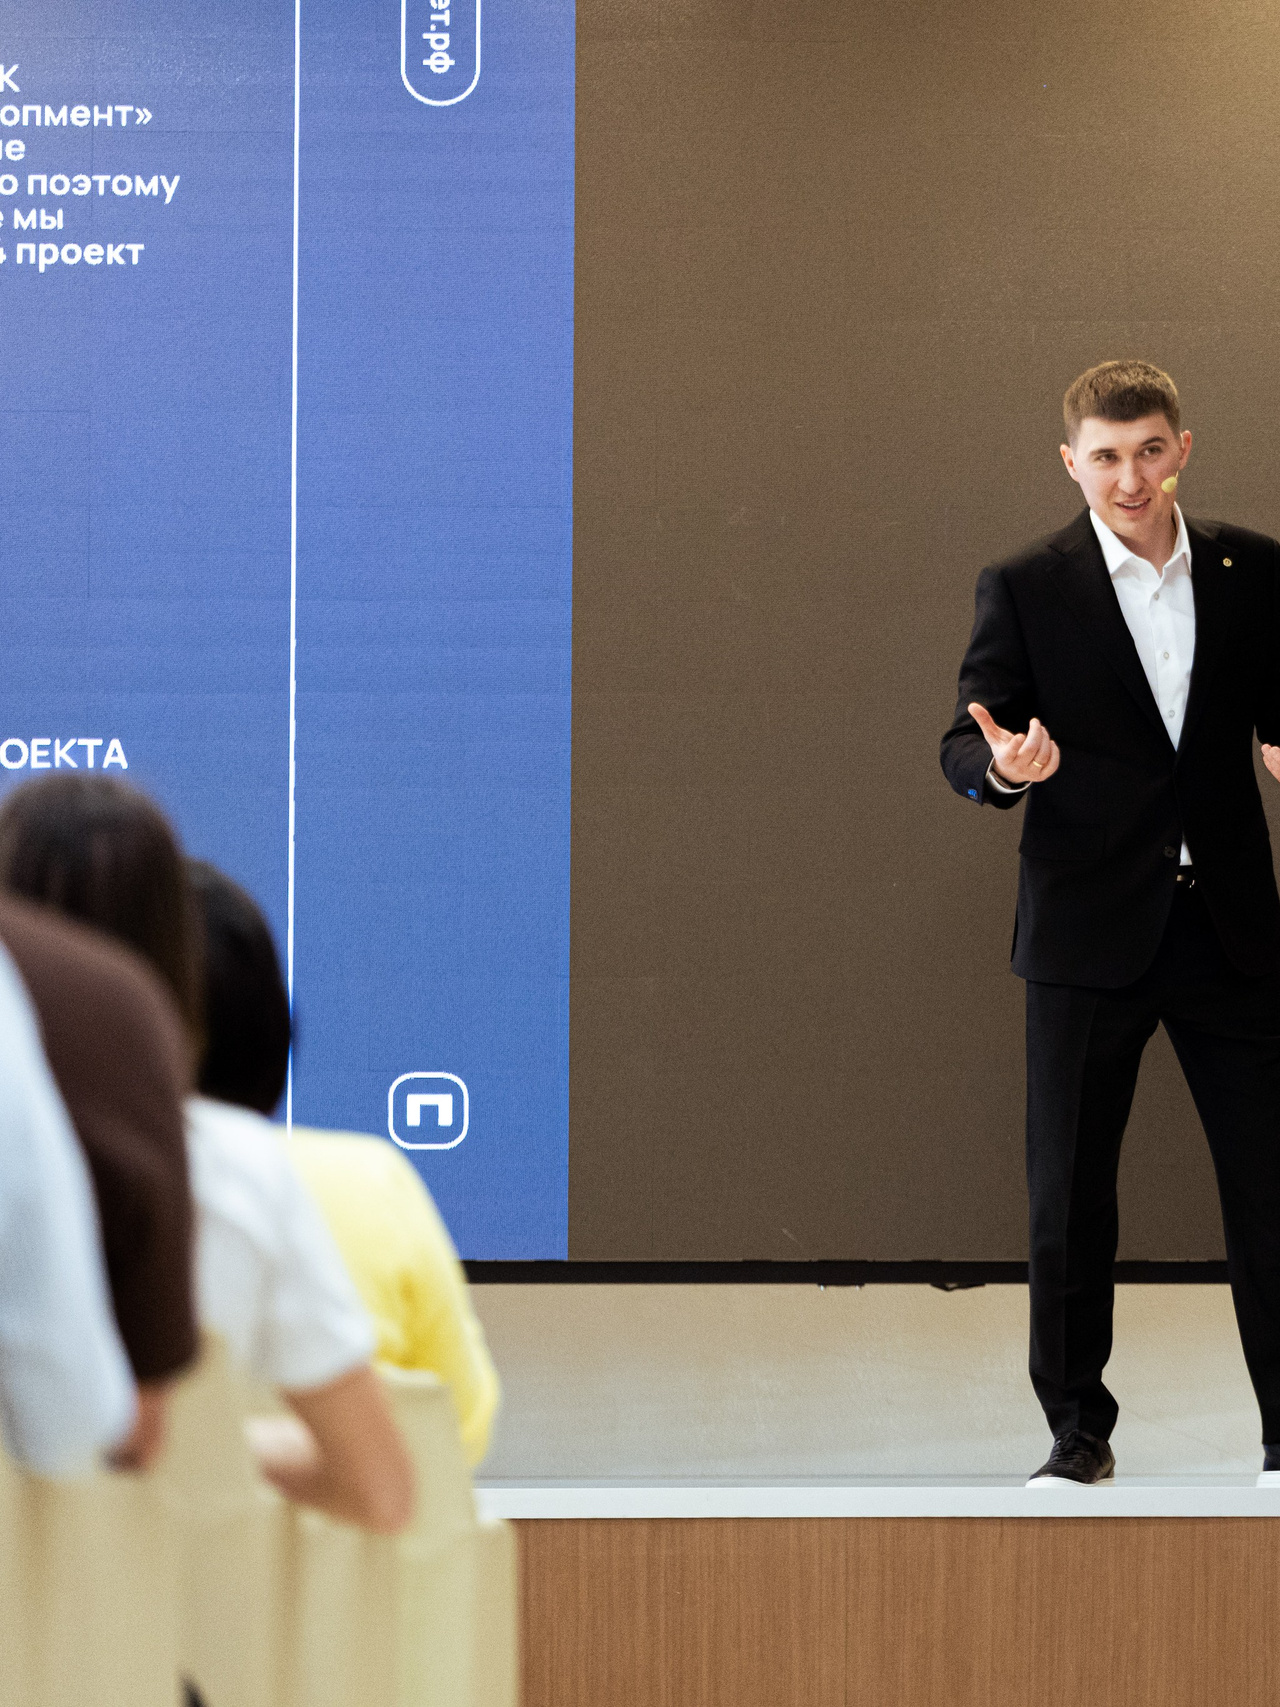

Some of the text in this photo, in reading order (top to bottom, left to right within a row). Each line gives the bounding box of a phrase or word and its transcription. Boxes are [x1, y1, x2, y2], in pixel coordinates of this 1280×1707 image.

[0, 105, 153, 127] опмент»
[28, 174, 180, 203] поэтому
[14, 208, 63, 230] мы
[17, 243, 144, 273] проект
[0, 738, 128, 769] ОЕКТА
